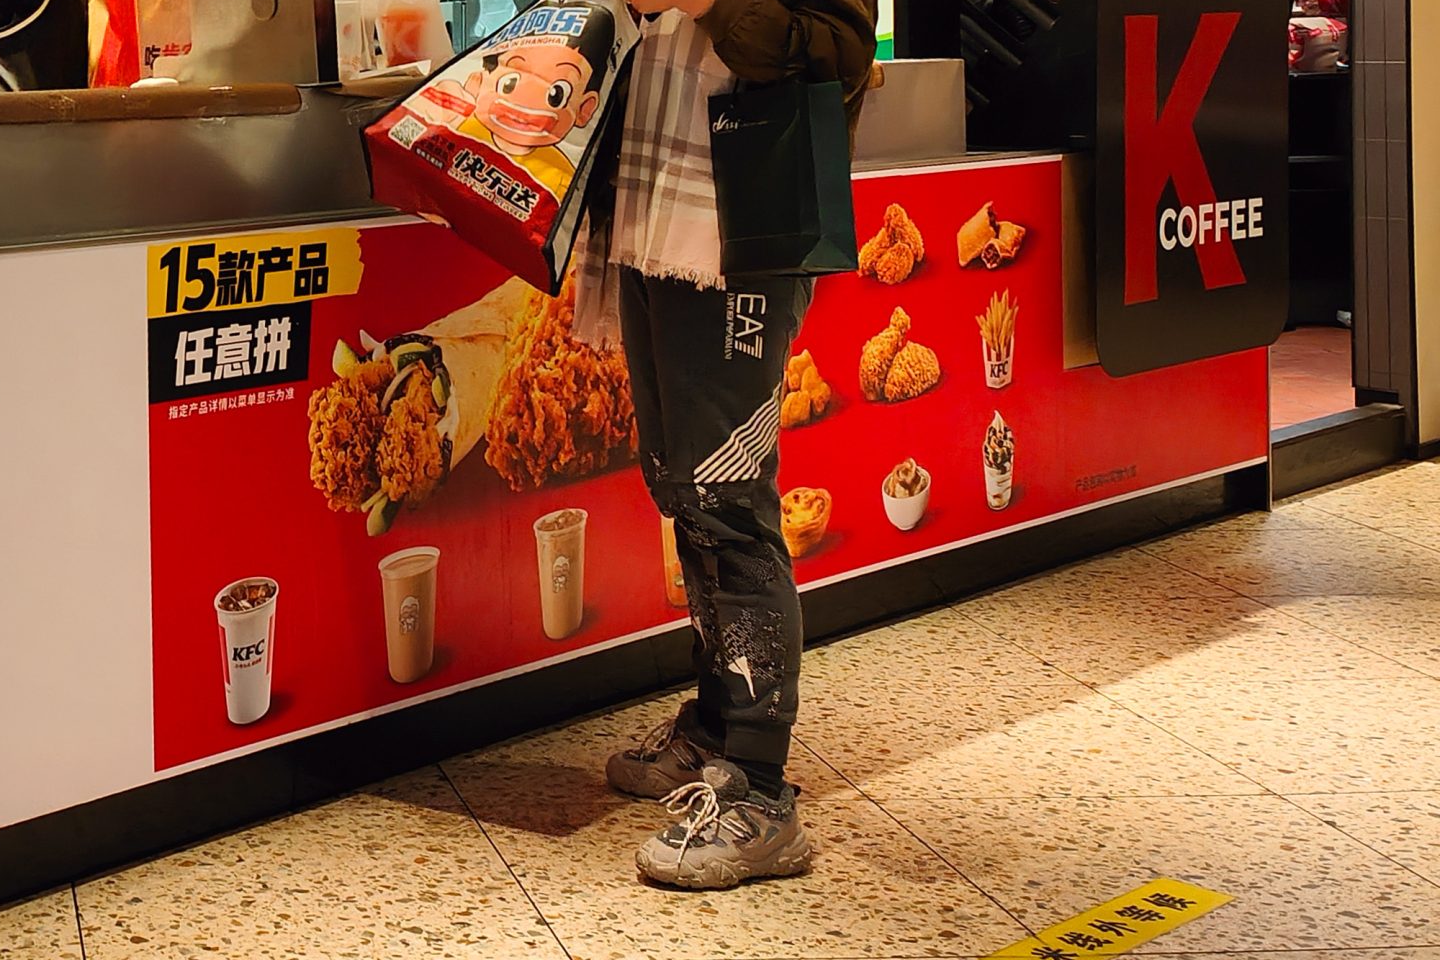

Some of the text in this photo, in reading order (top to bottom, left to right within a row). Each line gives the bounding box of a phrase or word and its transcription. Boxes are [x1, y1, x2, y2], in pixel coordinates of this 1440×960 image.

[453, 149, 538, 214] 快乐送
[1123, 12, 1247, 305] K
[1159, 197, 1264, 250] COFFEE
[160, 243, 329, 313] 15款产品
[175, 316, 292, 387] 任意拼
[734, 293, 767, 359] EA7
[990, 360, 1009, 378] KFC
[168, 388, 295, 420] 指定产品详情以菜单显示为准
[232, 638, 265, 661] KFC
